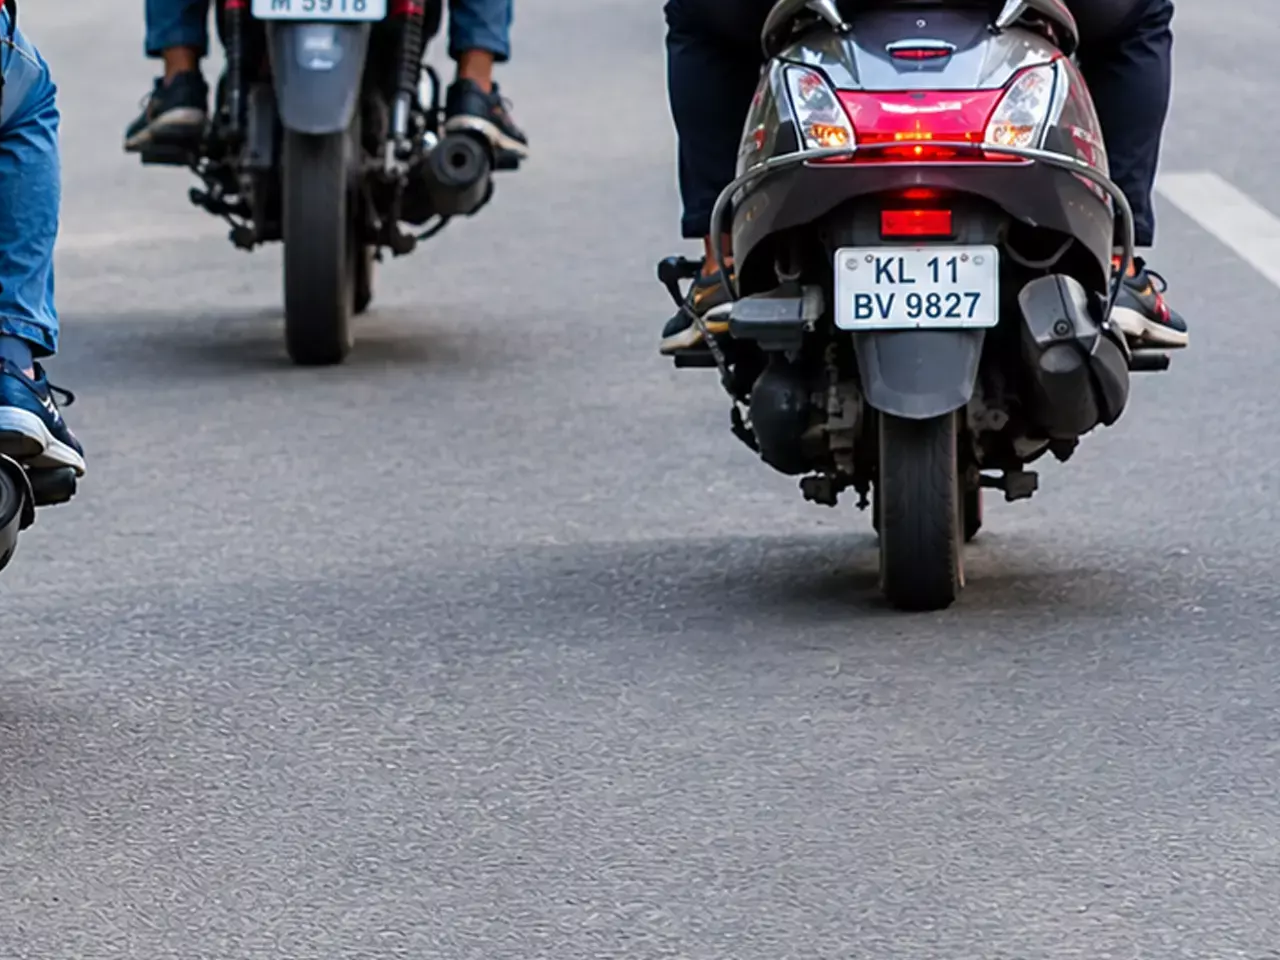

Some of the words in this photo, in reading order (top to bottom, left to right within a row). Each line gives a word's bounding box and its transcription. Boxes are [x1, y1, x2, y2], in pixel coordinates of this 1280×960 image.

[875, 256, 916, 284] KL
[927, 256, 958, 283] 11
[853, 292, 896, 319] BV
[905, 292, 982, 319] 9827
